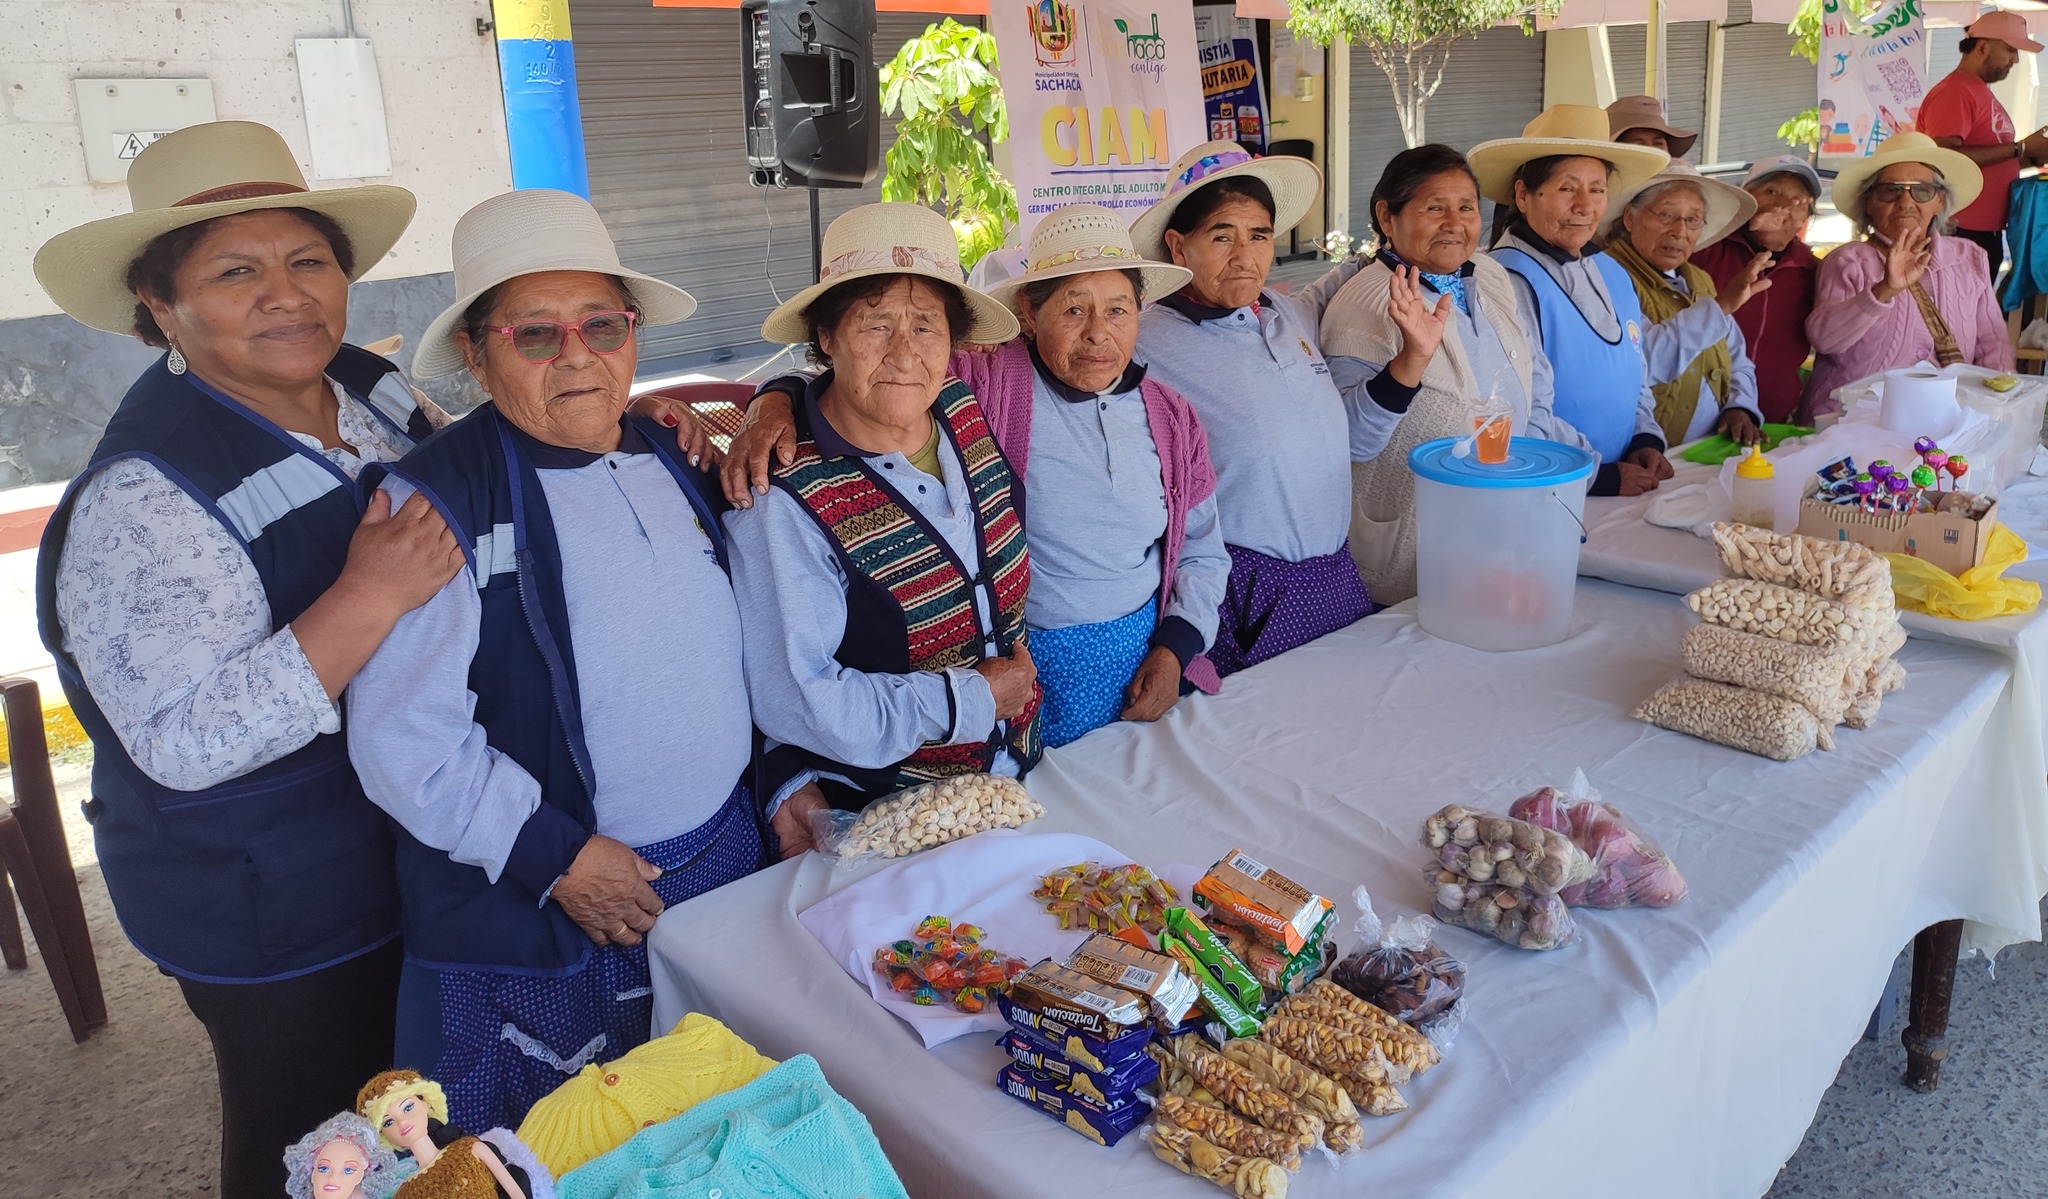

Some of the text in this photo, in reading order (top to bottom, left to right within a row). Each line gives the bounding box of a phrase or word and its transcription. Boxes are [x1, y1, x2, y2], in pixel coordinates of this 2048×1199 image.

[1199, 41, 1231, 64] NISTÍA
[1035, 79, 1082, 91] SACHACA
[1202, 64, 1249, 89] BUTARIA
[1041, 105, 1169, 166] CIAM
[1212, 122, 1233, 140] 31
[1033, 186, 1071, 198] CENTRO
[1073, 185, 1111, 196] INTEGRAL
[1113, 184, 1127, 194] DEL
[1128, 183, 1158, 193] ADULTO
[1042, 1006, 1103, 1033] Tentación
